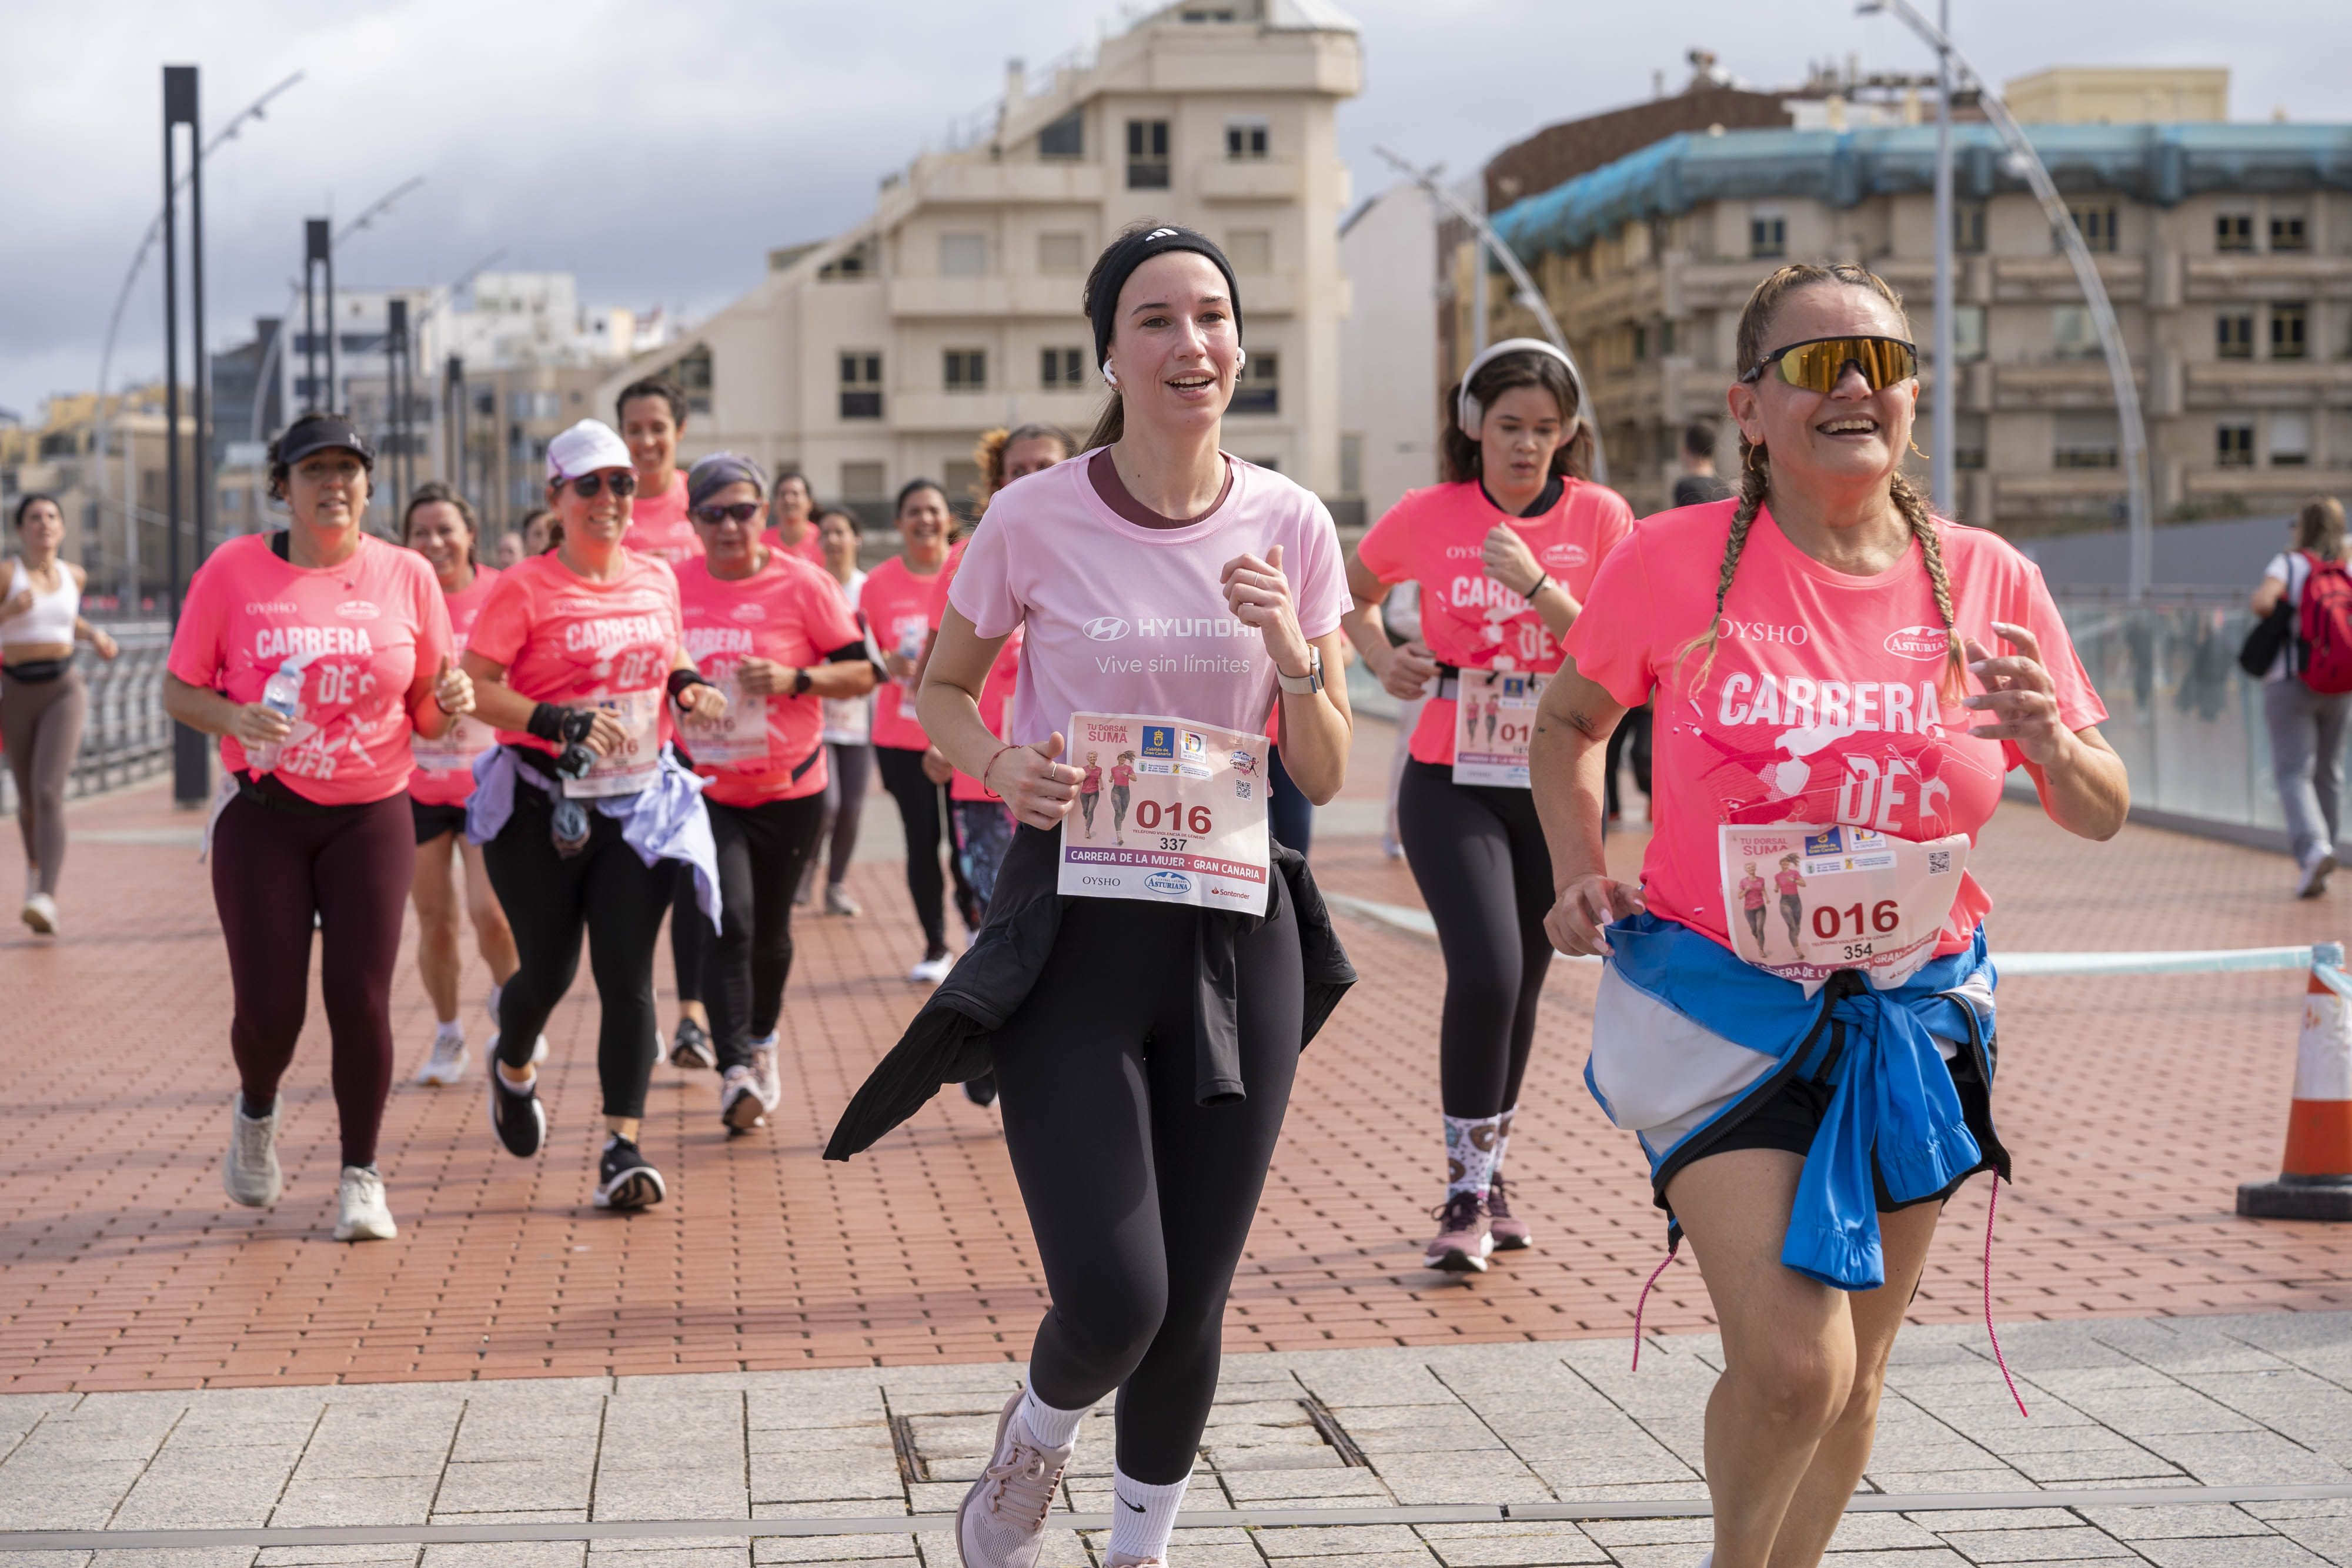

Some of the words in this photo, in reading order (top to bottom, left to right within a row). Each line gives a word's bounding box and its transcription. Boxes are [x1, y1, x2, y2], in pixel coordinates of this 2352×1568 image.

[1446, 546, 1483, 559] OYS
[565, 614, 665, 652] CARRERA
[1717, 618, 1808, 646] OYSHO
[256, 626, 373, 659] CARRERA
[1518, 623, 1556, 661] DE
[1095, 655, 1142, 673] Vive
[1149, 654, 1177, 672] sin
[1184, 653, 1250, 673] límites
[1718, 672, 1945, 738] CARRERA
[1088, 731, 1128, 744] SUMA
[1098, 724, 1128, 733] DORSAL
[1501, 724, 1529, 742] 01
[1833, 753, 1916, 833] DE
[1136, 800, 1212, 835] 016
[1160, 837, 1187, 851] 337
[1743, 845, 1789, 856] SUMA
[1071, 850, 1117, 862] CARRERA
[1120, 853, 1132, 862] DE
[1135, 854, 1148, 864] LA
[1151, 855, 1185, 867] MUJER
[1194, 859, 1219, 872] GRAN
[1221, 864, 1260, 880] CANARIA
[1083, 875, 1121, 887] OYSHO
[1148, 878, 1188, 890] ASTURIANA
[1220, 889, 1250, 900] Santander
[1812, 900, 1899, 939] 016
[1844, 942, 1873, 960] 354
[1802, 966, 1815, 978] DE
